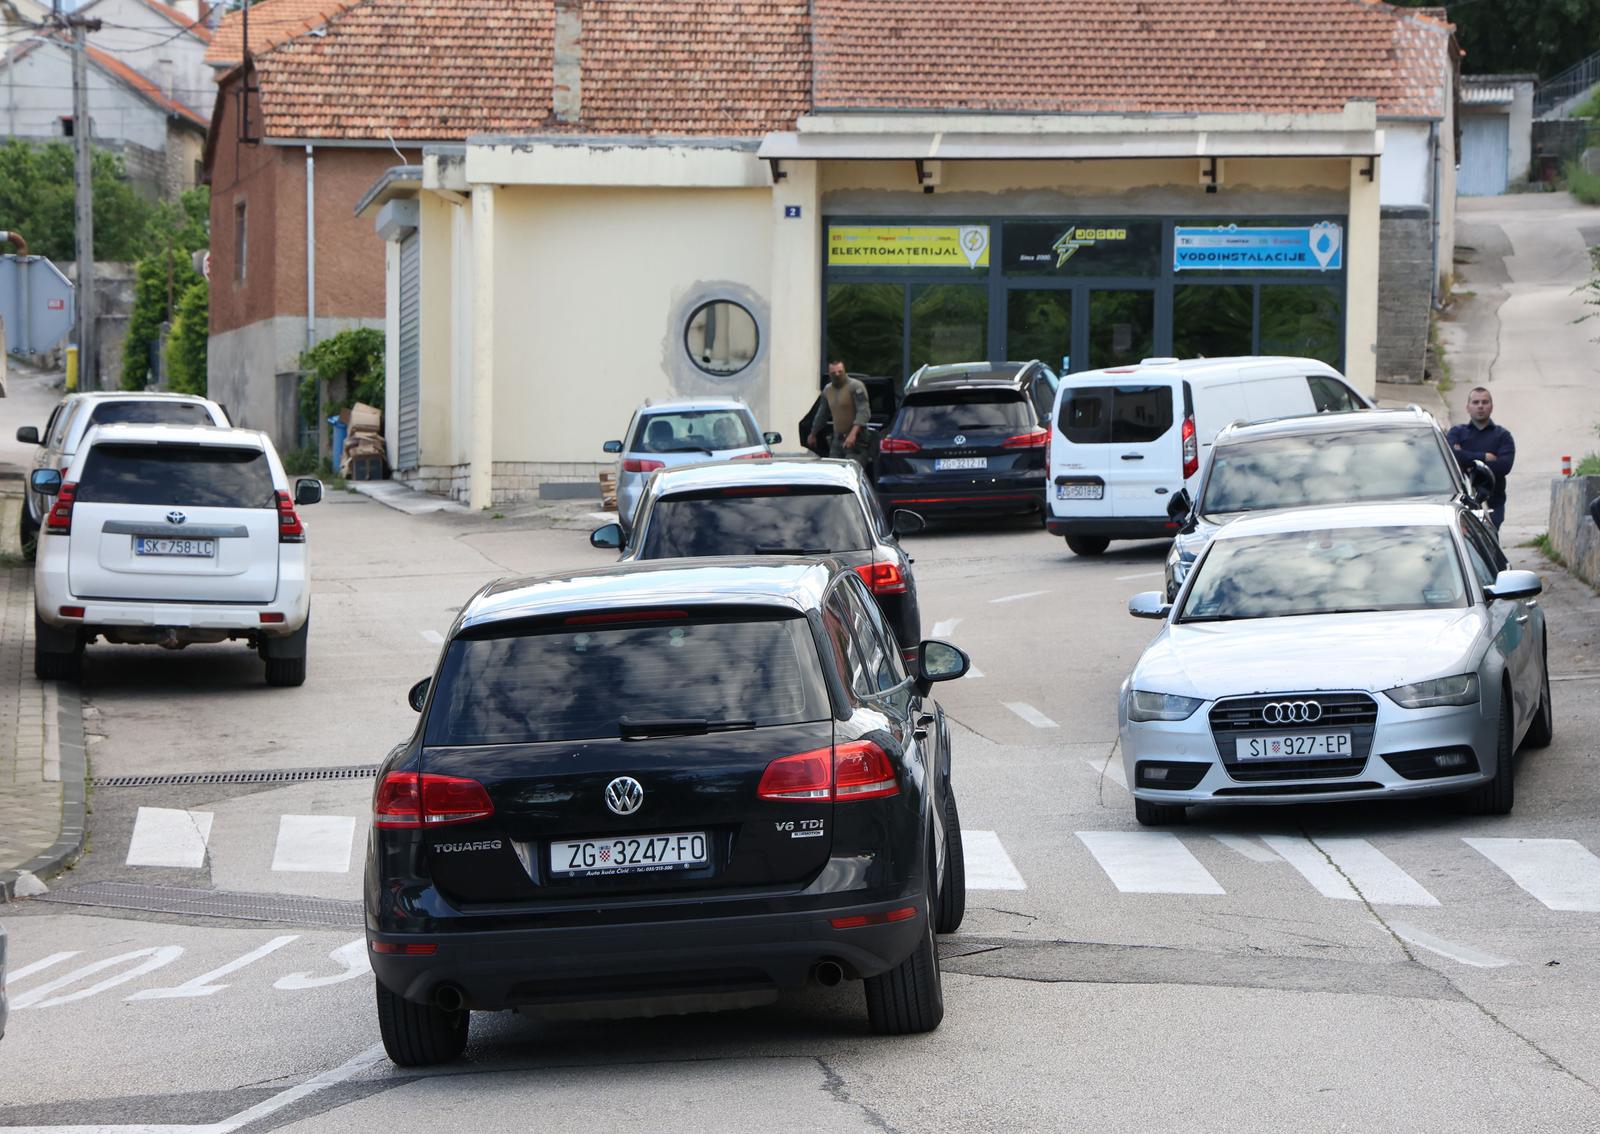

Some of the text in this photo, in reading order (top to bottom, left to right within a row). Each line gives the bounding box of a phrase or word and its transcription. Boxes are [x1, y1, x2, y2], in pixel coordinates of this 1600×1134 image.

[789, 207, 797, 216] 2
[1076, 230, 1125, 238] JOSIP
[831, 247, 958, 256] ELEKTROMATERIJAL
[1179, 252, 1306, 262] VODOINSTALACIJE
[145, 540, 212, 554] SK 758-LC
[1250, 735, 1347, 757] SI 927-EP
[775, 821, 795, 832] V6
[434, 840, 502, 853] TOUAREG
[568, 835, 705, 869] ZG 3247-FO
